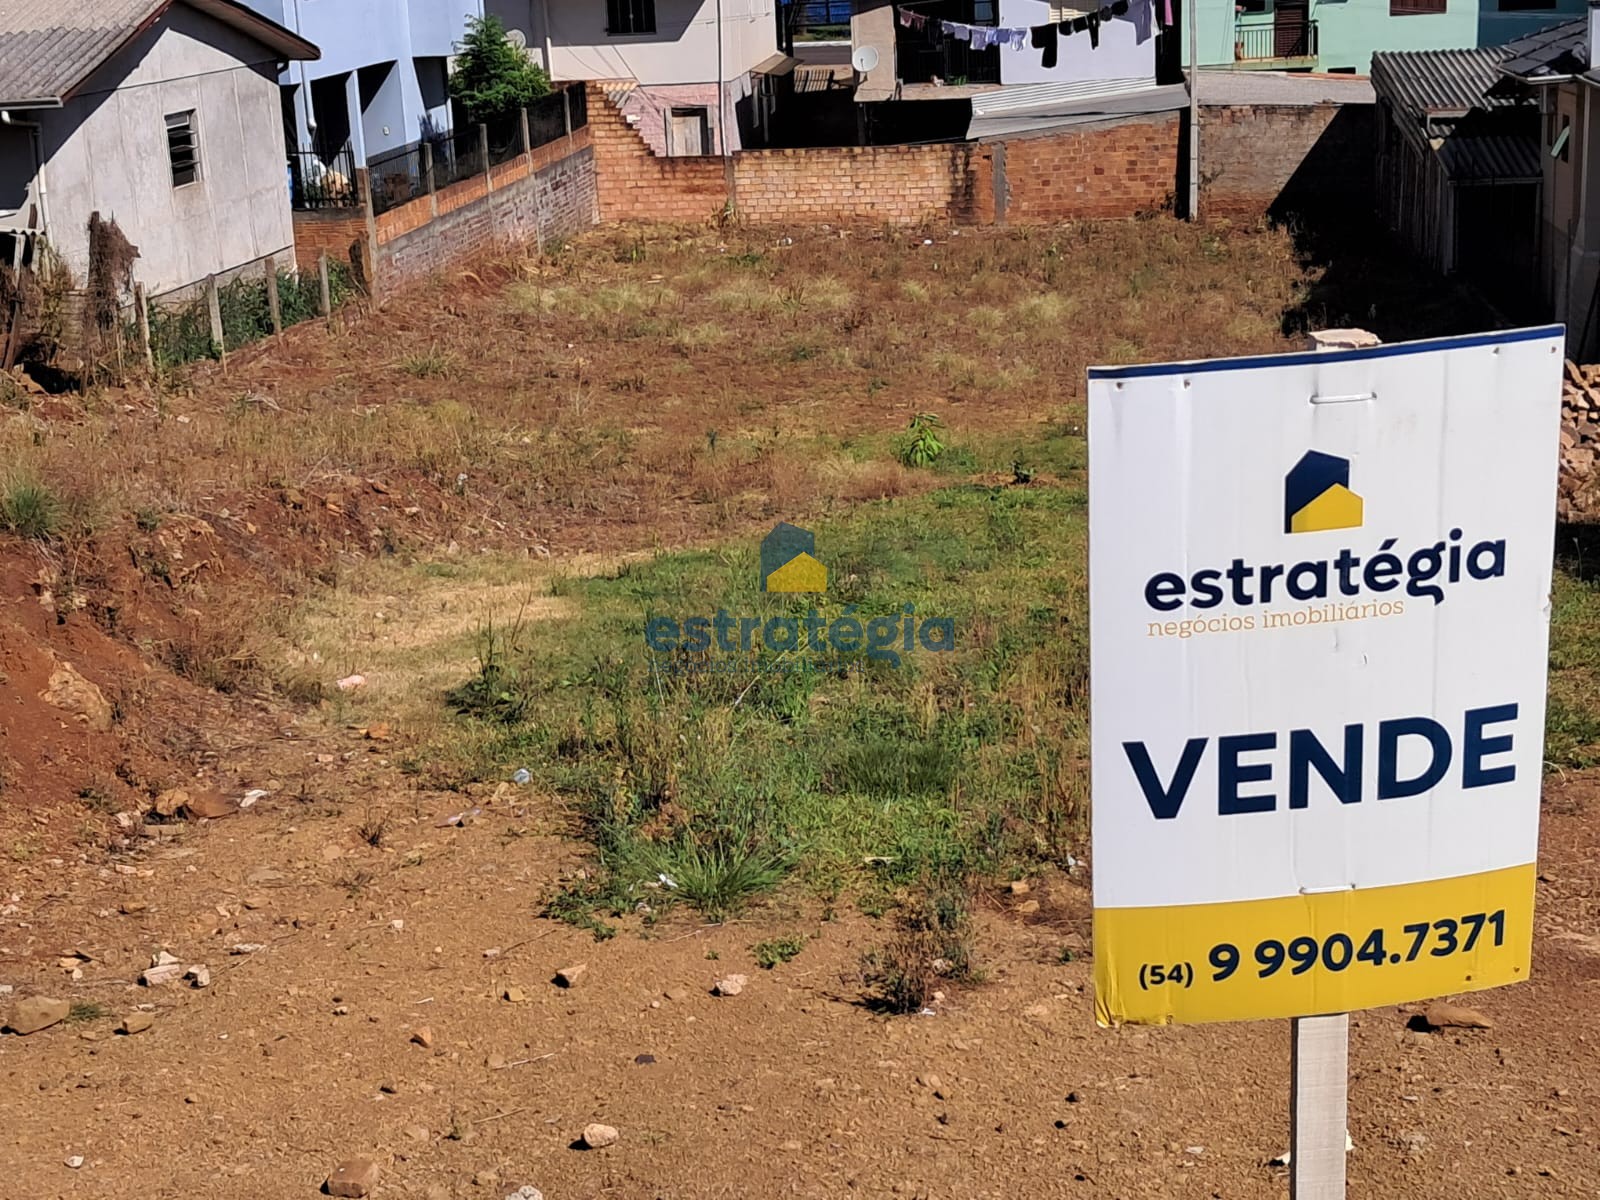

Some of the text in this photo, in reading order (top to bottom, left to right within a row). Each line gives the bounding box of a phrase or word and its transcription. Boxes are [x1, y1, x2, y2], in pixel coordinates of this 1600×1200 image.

[1144, 528, 1506, 611] estratégia
[1147, 598, 1404, 639] negócios imobiliários
[1121, 702, 1519, 820] VENDE
[1138, 909, 1506, 991] (54) 9 9904.7371
